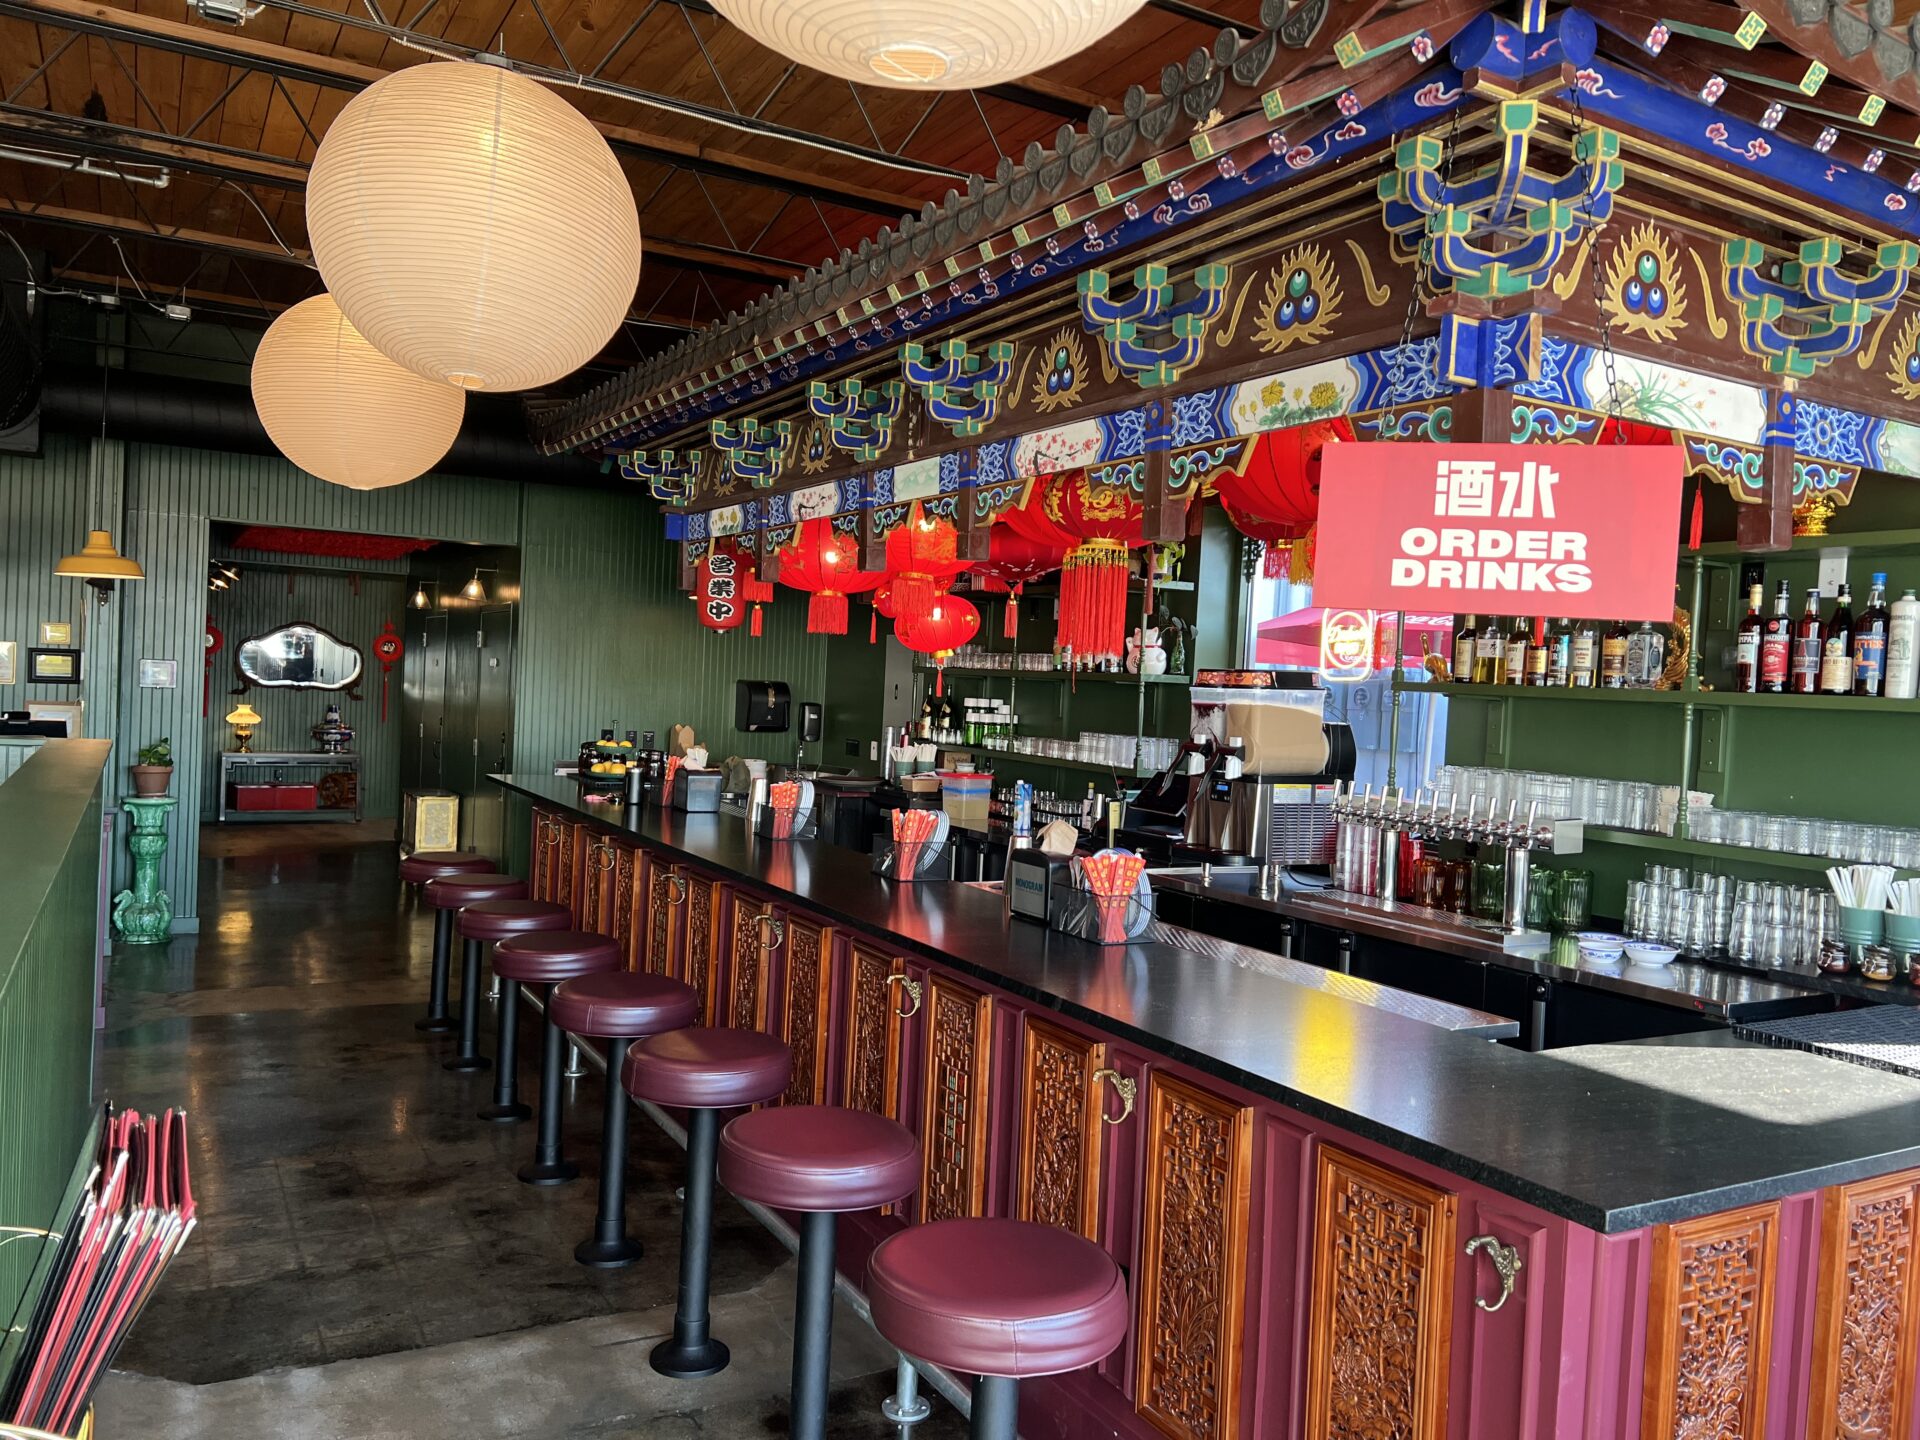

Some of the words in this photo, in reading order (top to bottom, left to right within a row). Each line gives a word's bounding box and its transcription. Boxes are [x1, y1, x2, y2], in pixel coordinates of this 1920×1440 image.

[1434, 460, 1559, 519] 酒水
[1400, 527, 1588, 561] ORDER
[1390, 558, 1593, 593] DRINKS
